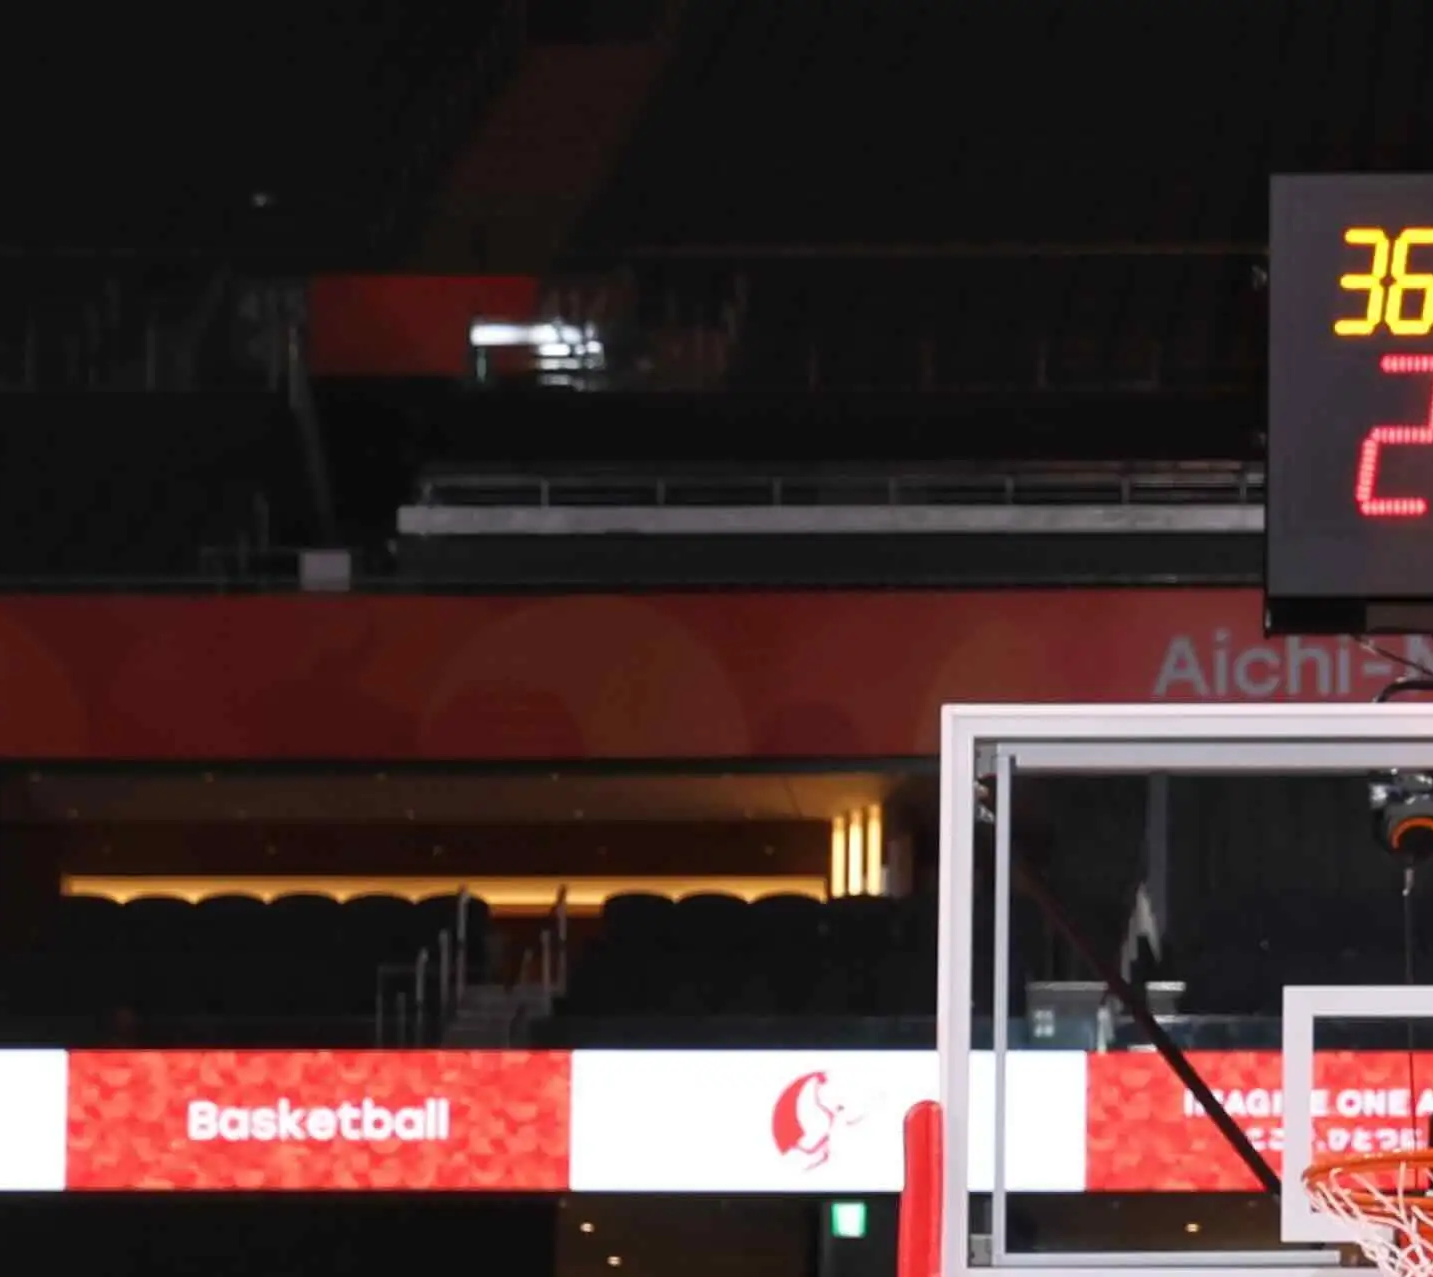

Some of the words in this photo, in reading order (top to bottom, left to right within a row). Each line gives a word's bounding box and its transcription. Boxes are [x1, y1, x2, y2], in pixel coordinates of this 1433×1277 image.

[186, 1098, 450, 1141] Basketball
[1183, 1087, 1329, 1118] IAGIE
[1336, 1087, 1409, 1118] ONE
